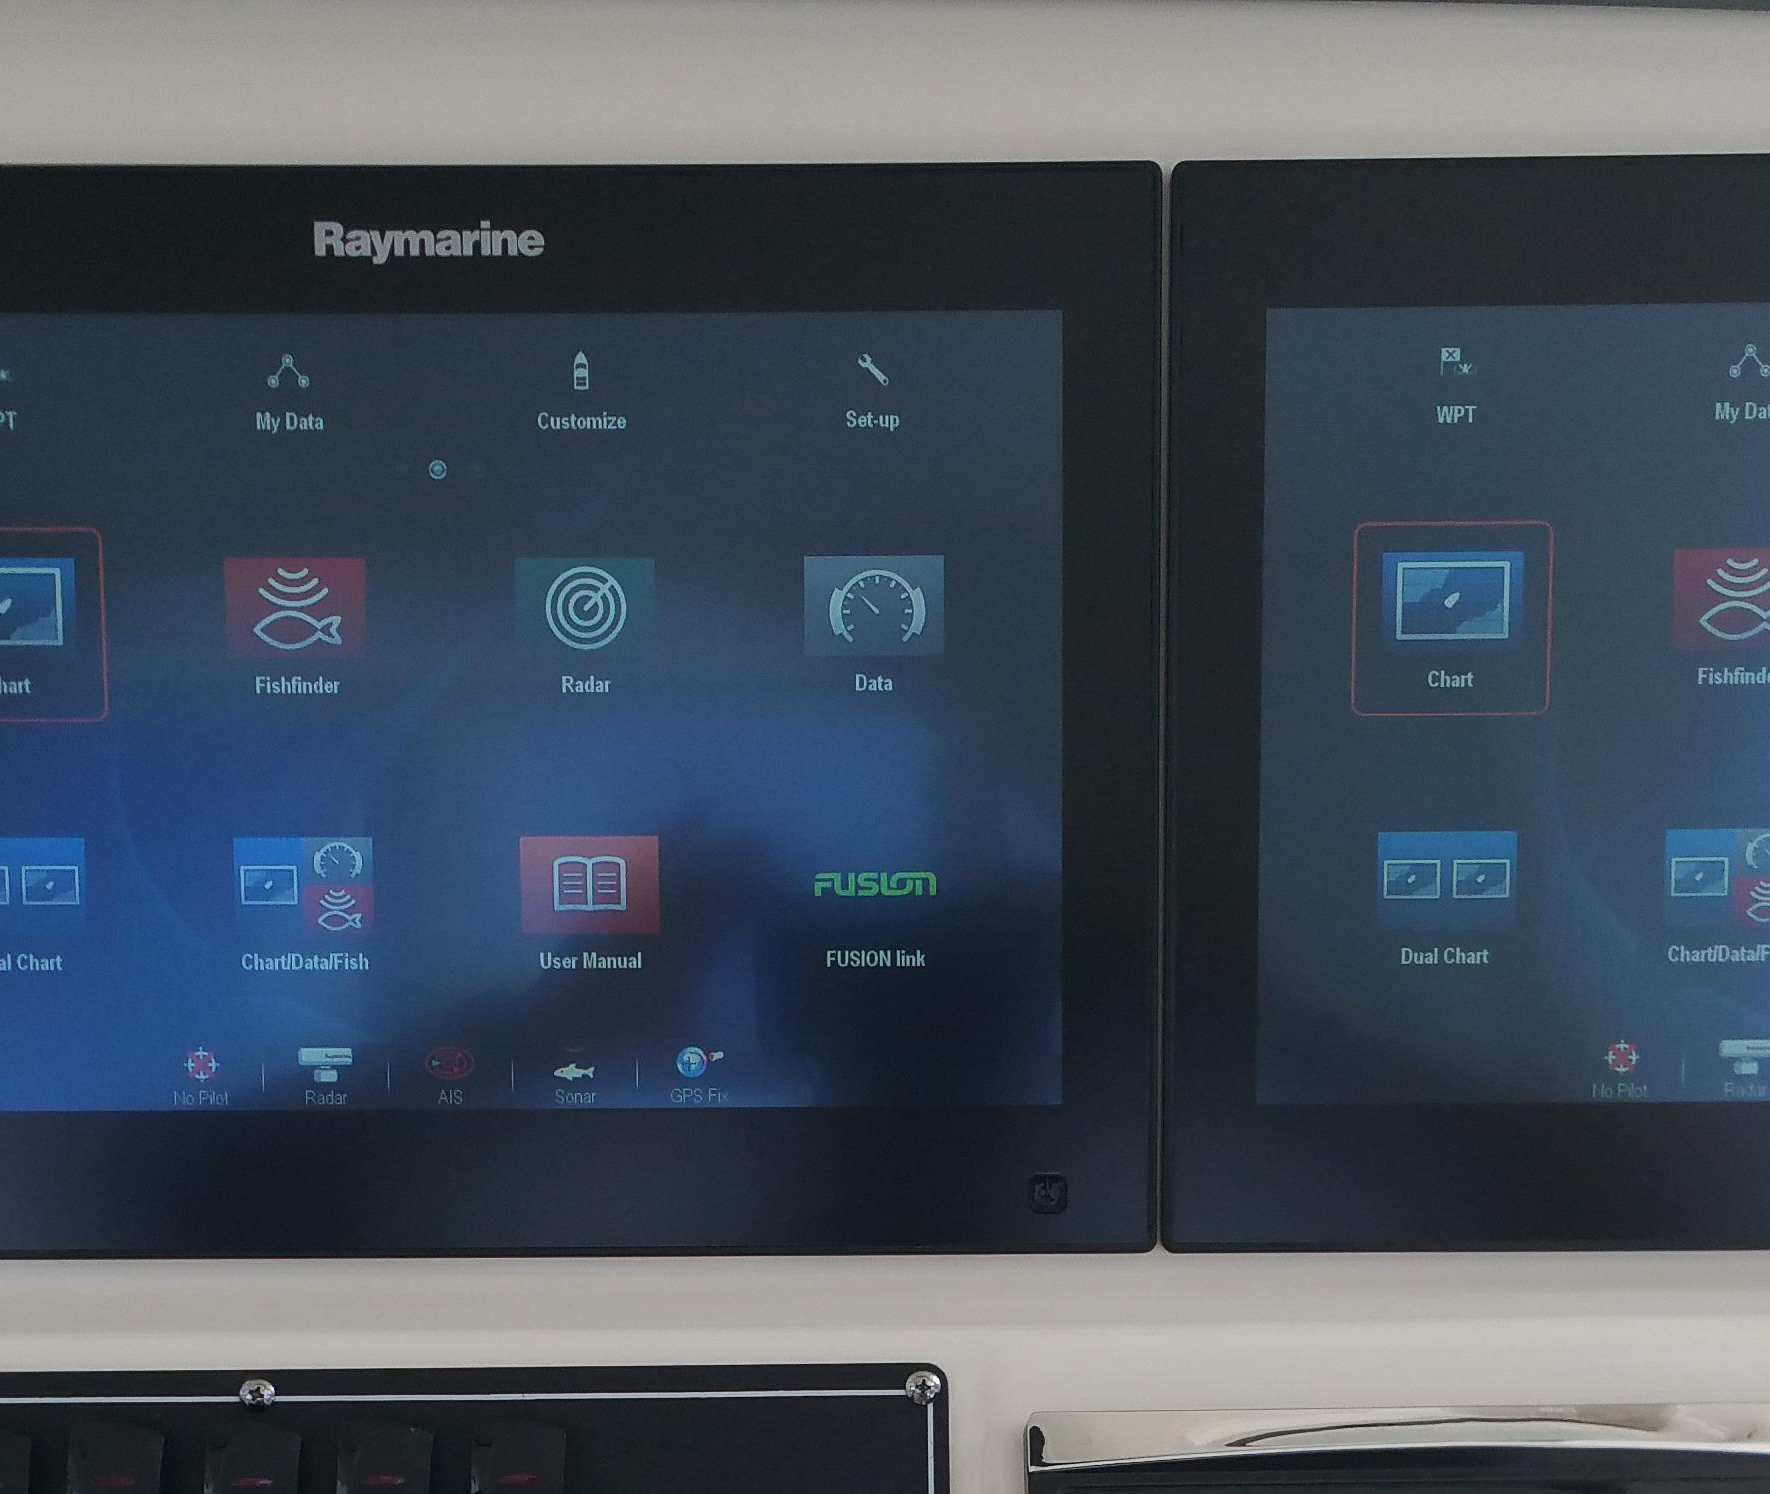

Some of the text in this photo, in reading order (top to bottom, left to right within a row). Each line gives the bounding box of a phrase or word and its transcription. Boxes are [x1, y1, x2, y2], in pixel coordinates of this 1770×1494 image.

[313, 220, 545, 264] Raymarine
[255, 411, 324, 434] My Data
[537, 411, 627, 431] Customize
[845, 410, 900, 432] Set-up
[1436, 405, 1477, 425] WPT
[1714, 402, 1739, 424] My
[254, 675, 340, 695] Fishfinder
[561, 675, 611, 694] Radar
[855, 673, 893, 692] Data
[1428, 670, 1474, 689] Chart
[814, 871, 937, 897] FUSION
[17, 953, 63, 971] Chart
[241, 953, 369, 972] Chart/Data/Fish
[539, 951, 642, 970] User Manual
[826, 950, 926, 968] FUSION link
[1400, 947, 1489, 965] Dual Chart
